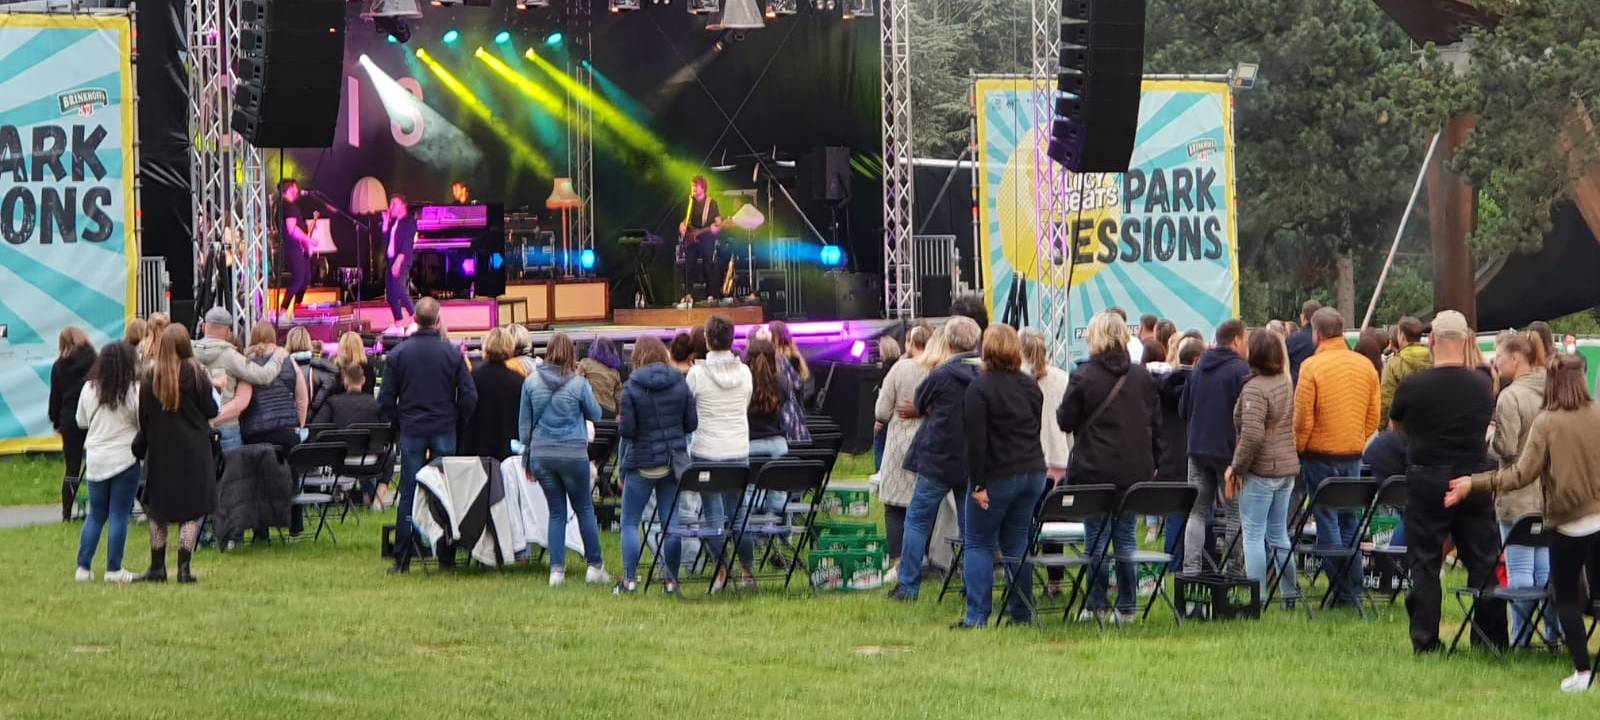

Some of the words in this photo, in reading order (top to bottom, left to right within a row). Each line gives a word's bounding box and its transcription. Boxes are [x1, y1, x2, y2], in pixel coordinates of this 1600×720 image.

[1122, 167, 1217, 213] PARK
[1, 187, 113, 245] ONS
[1052, 215, 1222, 265] SESSIONS
